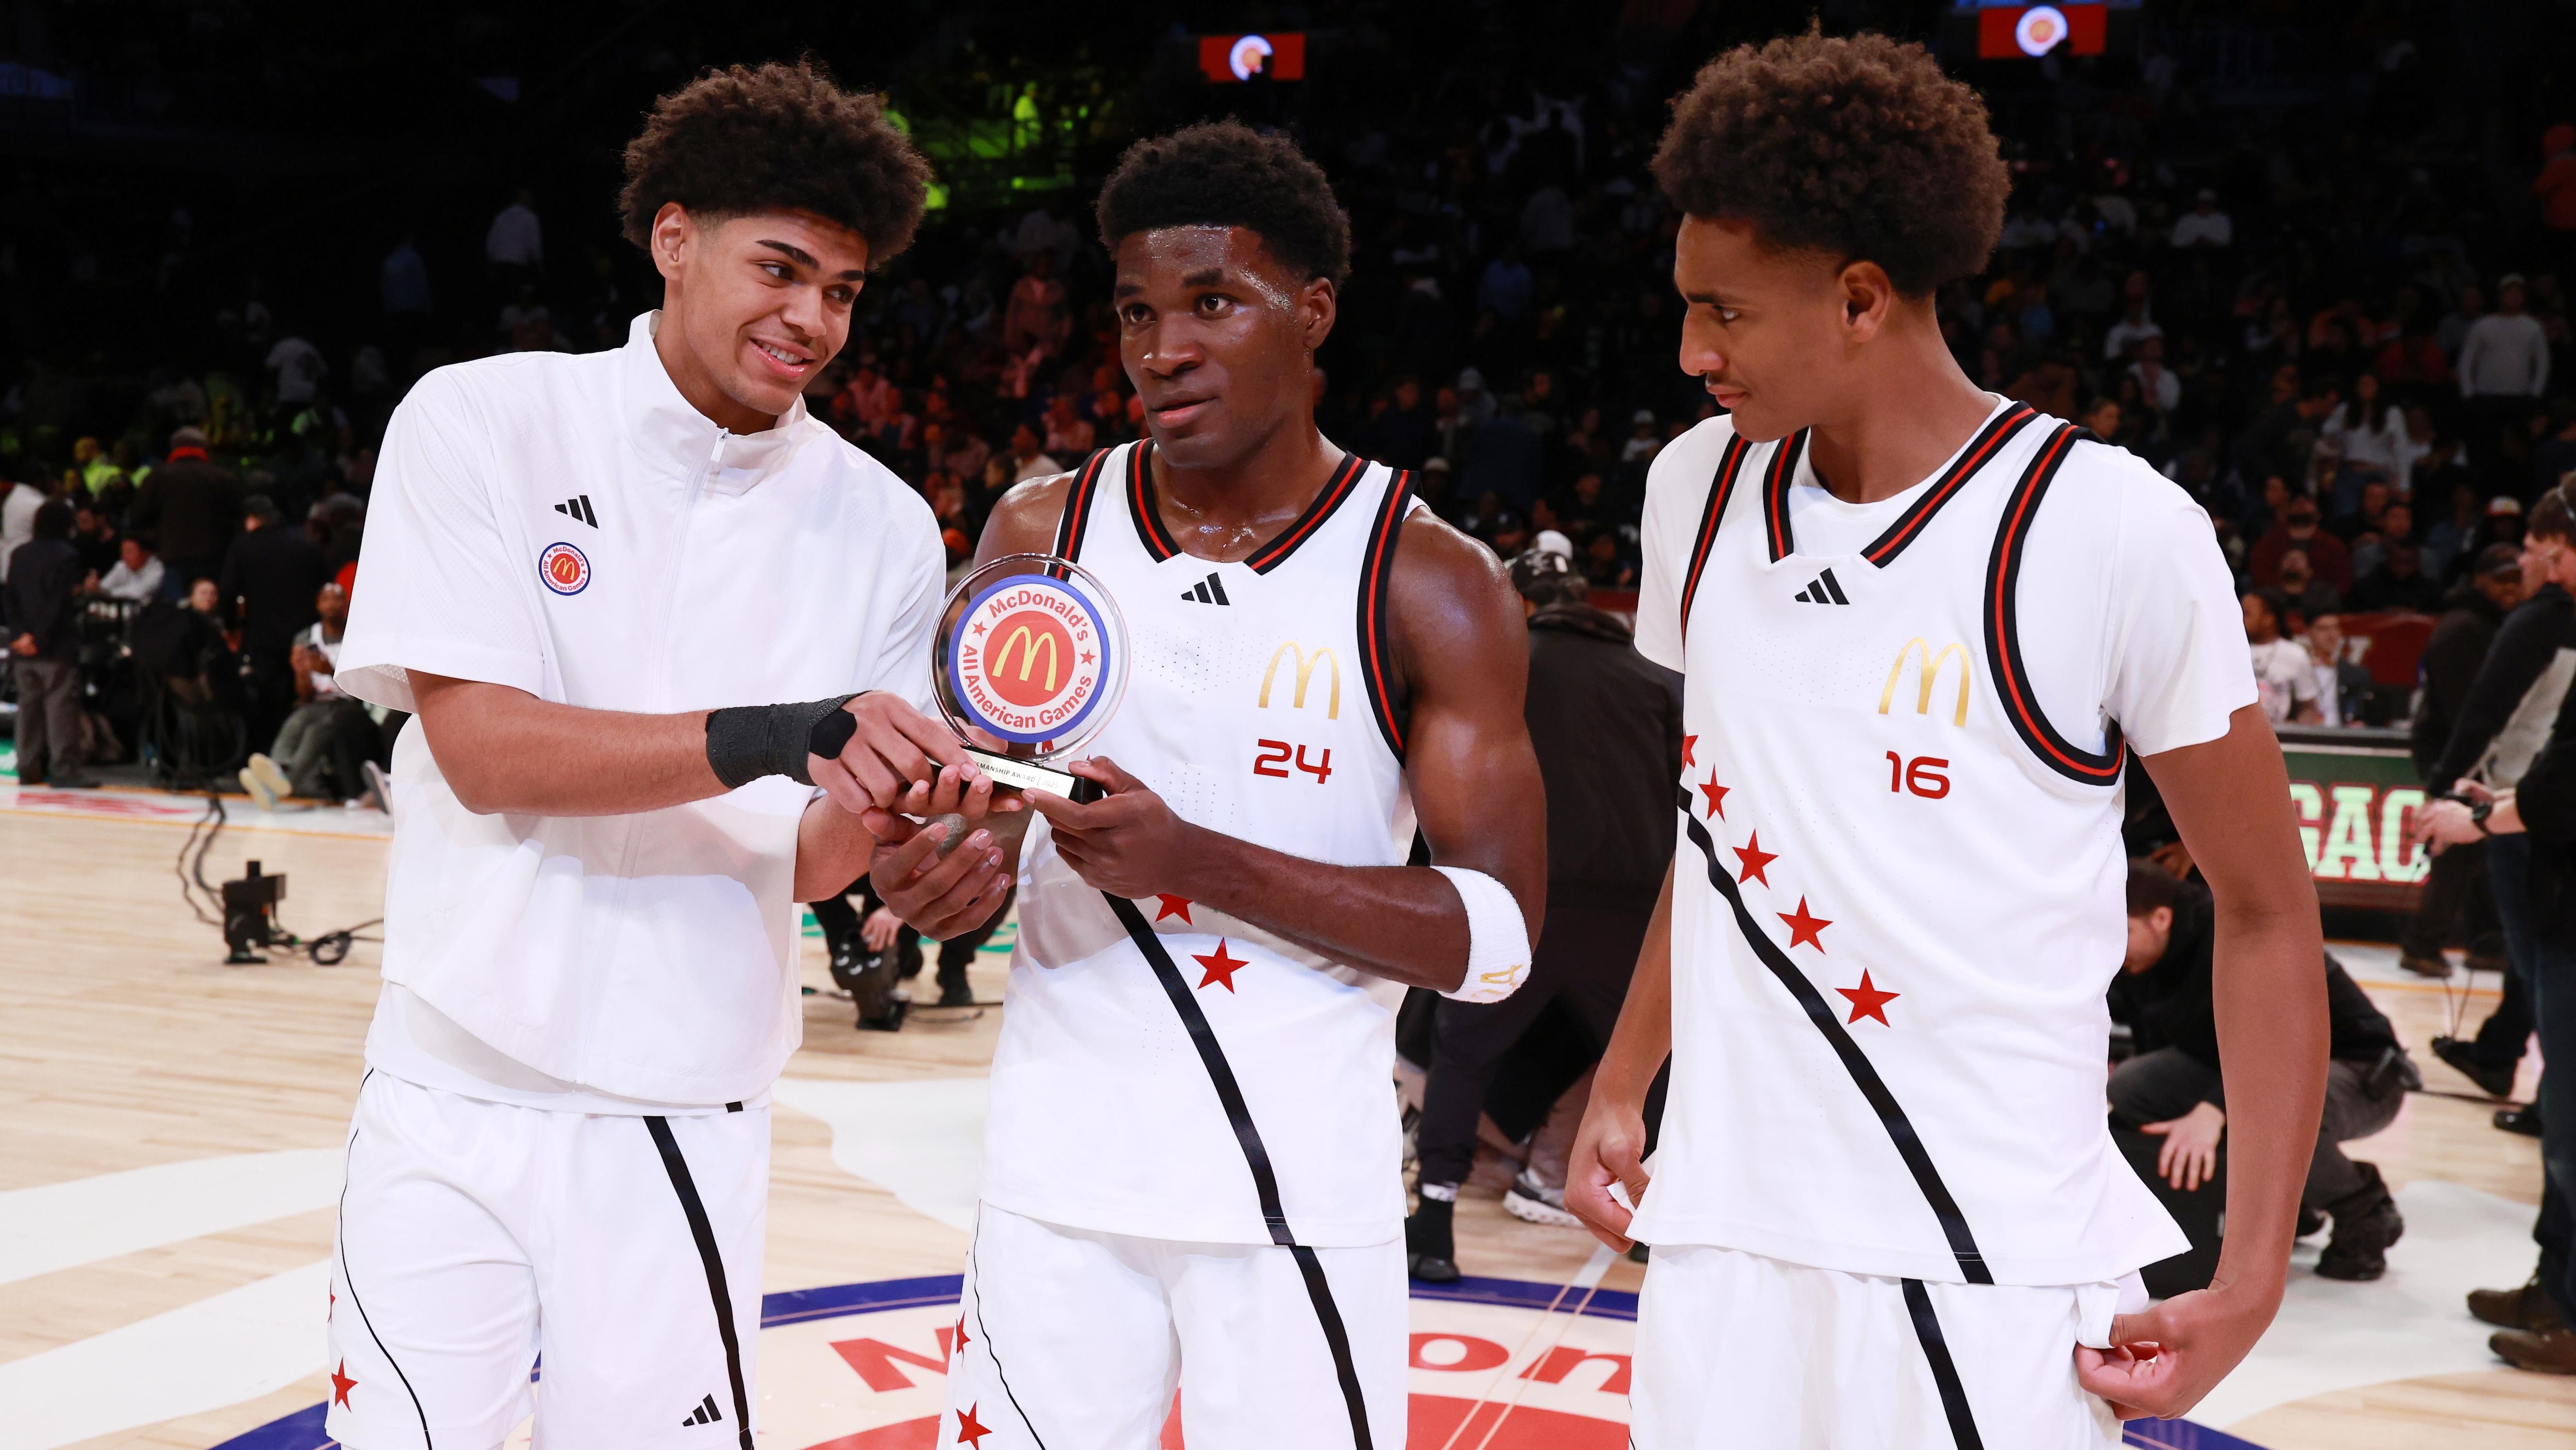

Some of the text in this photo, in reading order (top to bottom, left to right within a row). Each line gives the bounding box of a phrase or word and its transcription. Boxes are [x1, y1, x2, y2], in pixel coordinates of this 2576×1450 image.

[552, 546, 585, 567] McDonald's
[544, 570, 567, 591] American
[568, 577, 585, 591] Games
[988, 590, 1088, 641] McDonald's
[963, 644, 1091, 728] All American Games
[975, 761, 1059, 789] SMANSHIP AWARD 2025
[1253, 739, 1332, 784] 24
[1886, 750, 1950, 799] 16
